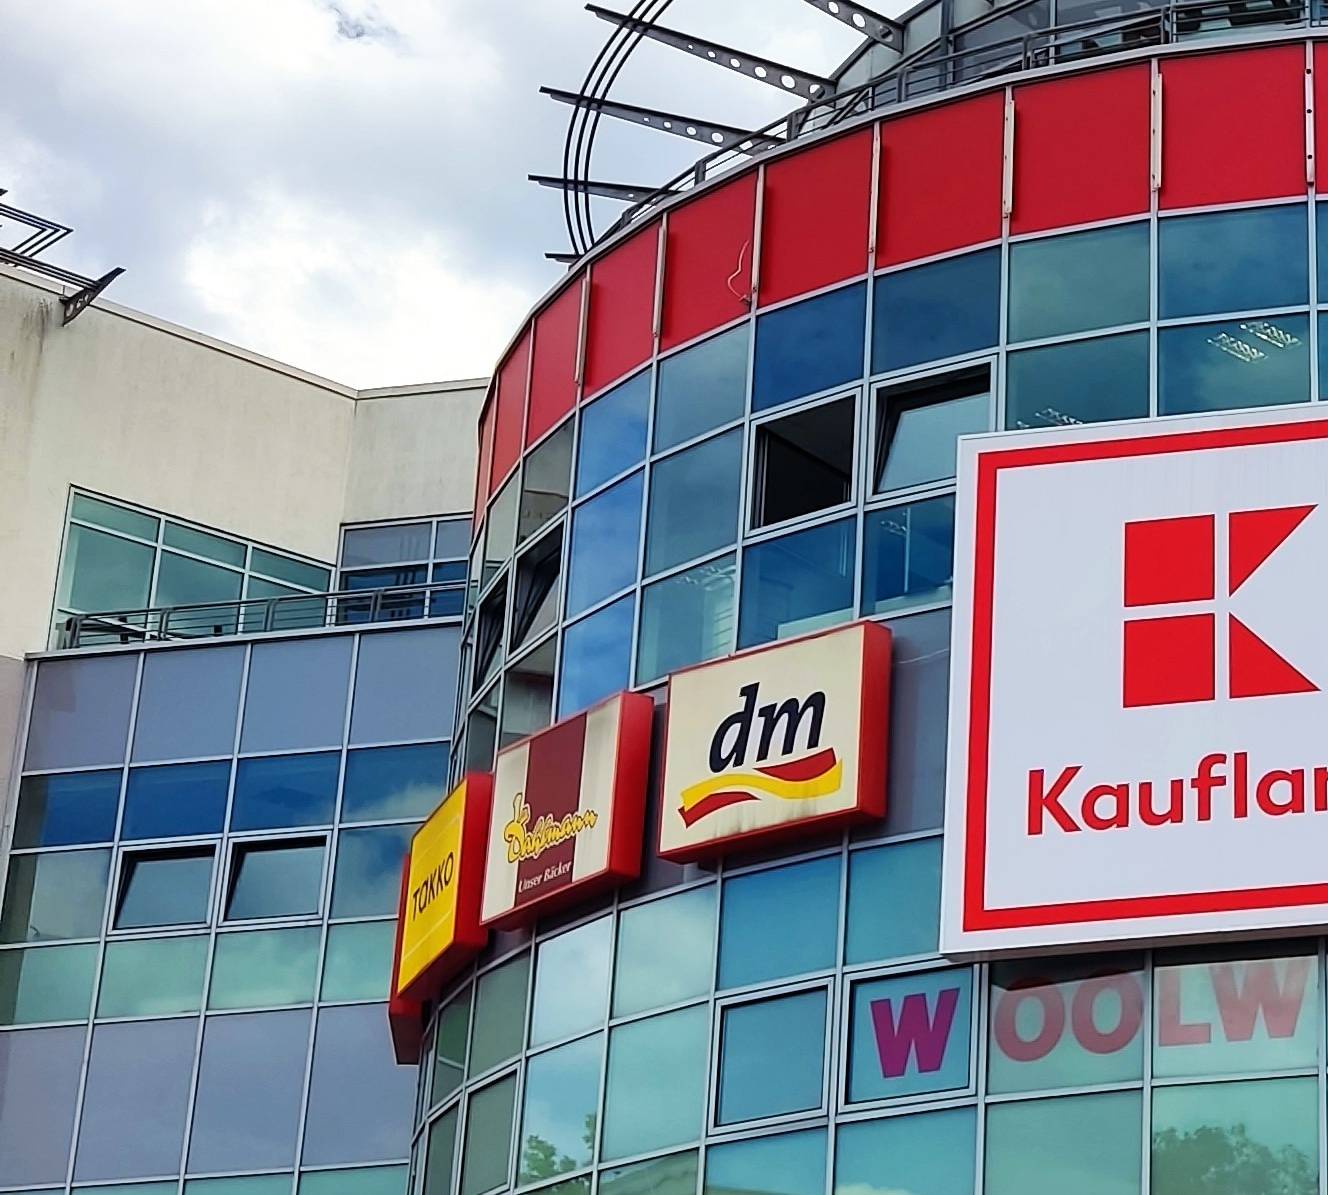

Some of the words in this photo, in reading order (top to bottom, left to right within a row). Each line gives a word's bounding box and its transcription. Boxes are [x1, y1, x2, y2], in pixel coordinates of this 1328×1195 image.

[709, 681, 826, 773] dm
[518, 874, 542, 892] Unser
[543, 861, 572, 882] Bäcker
